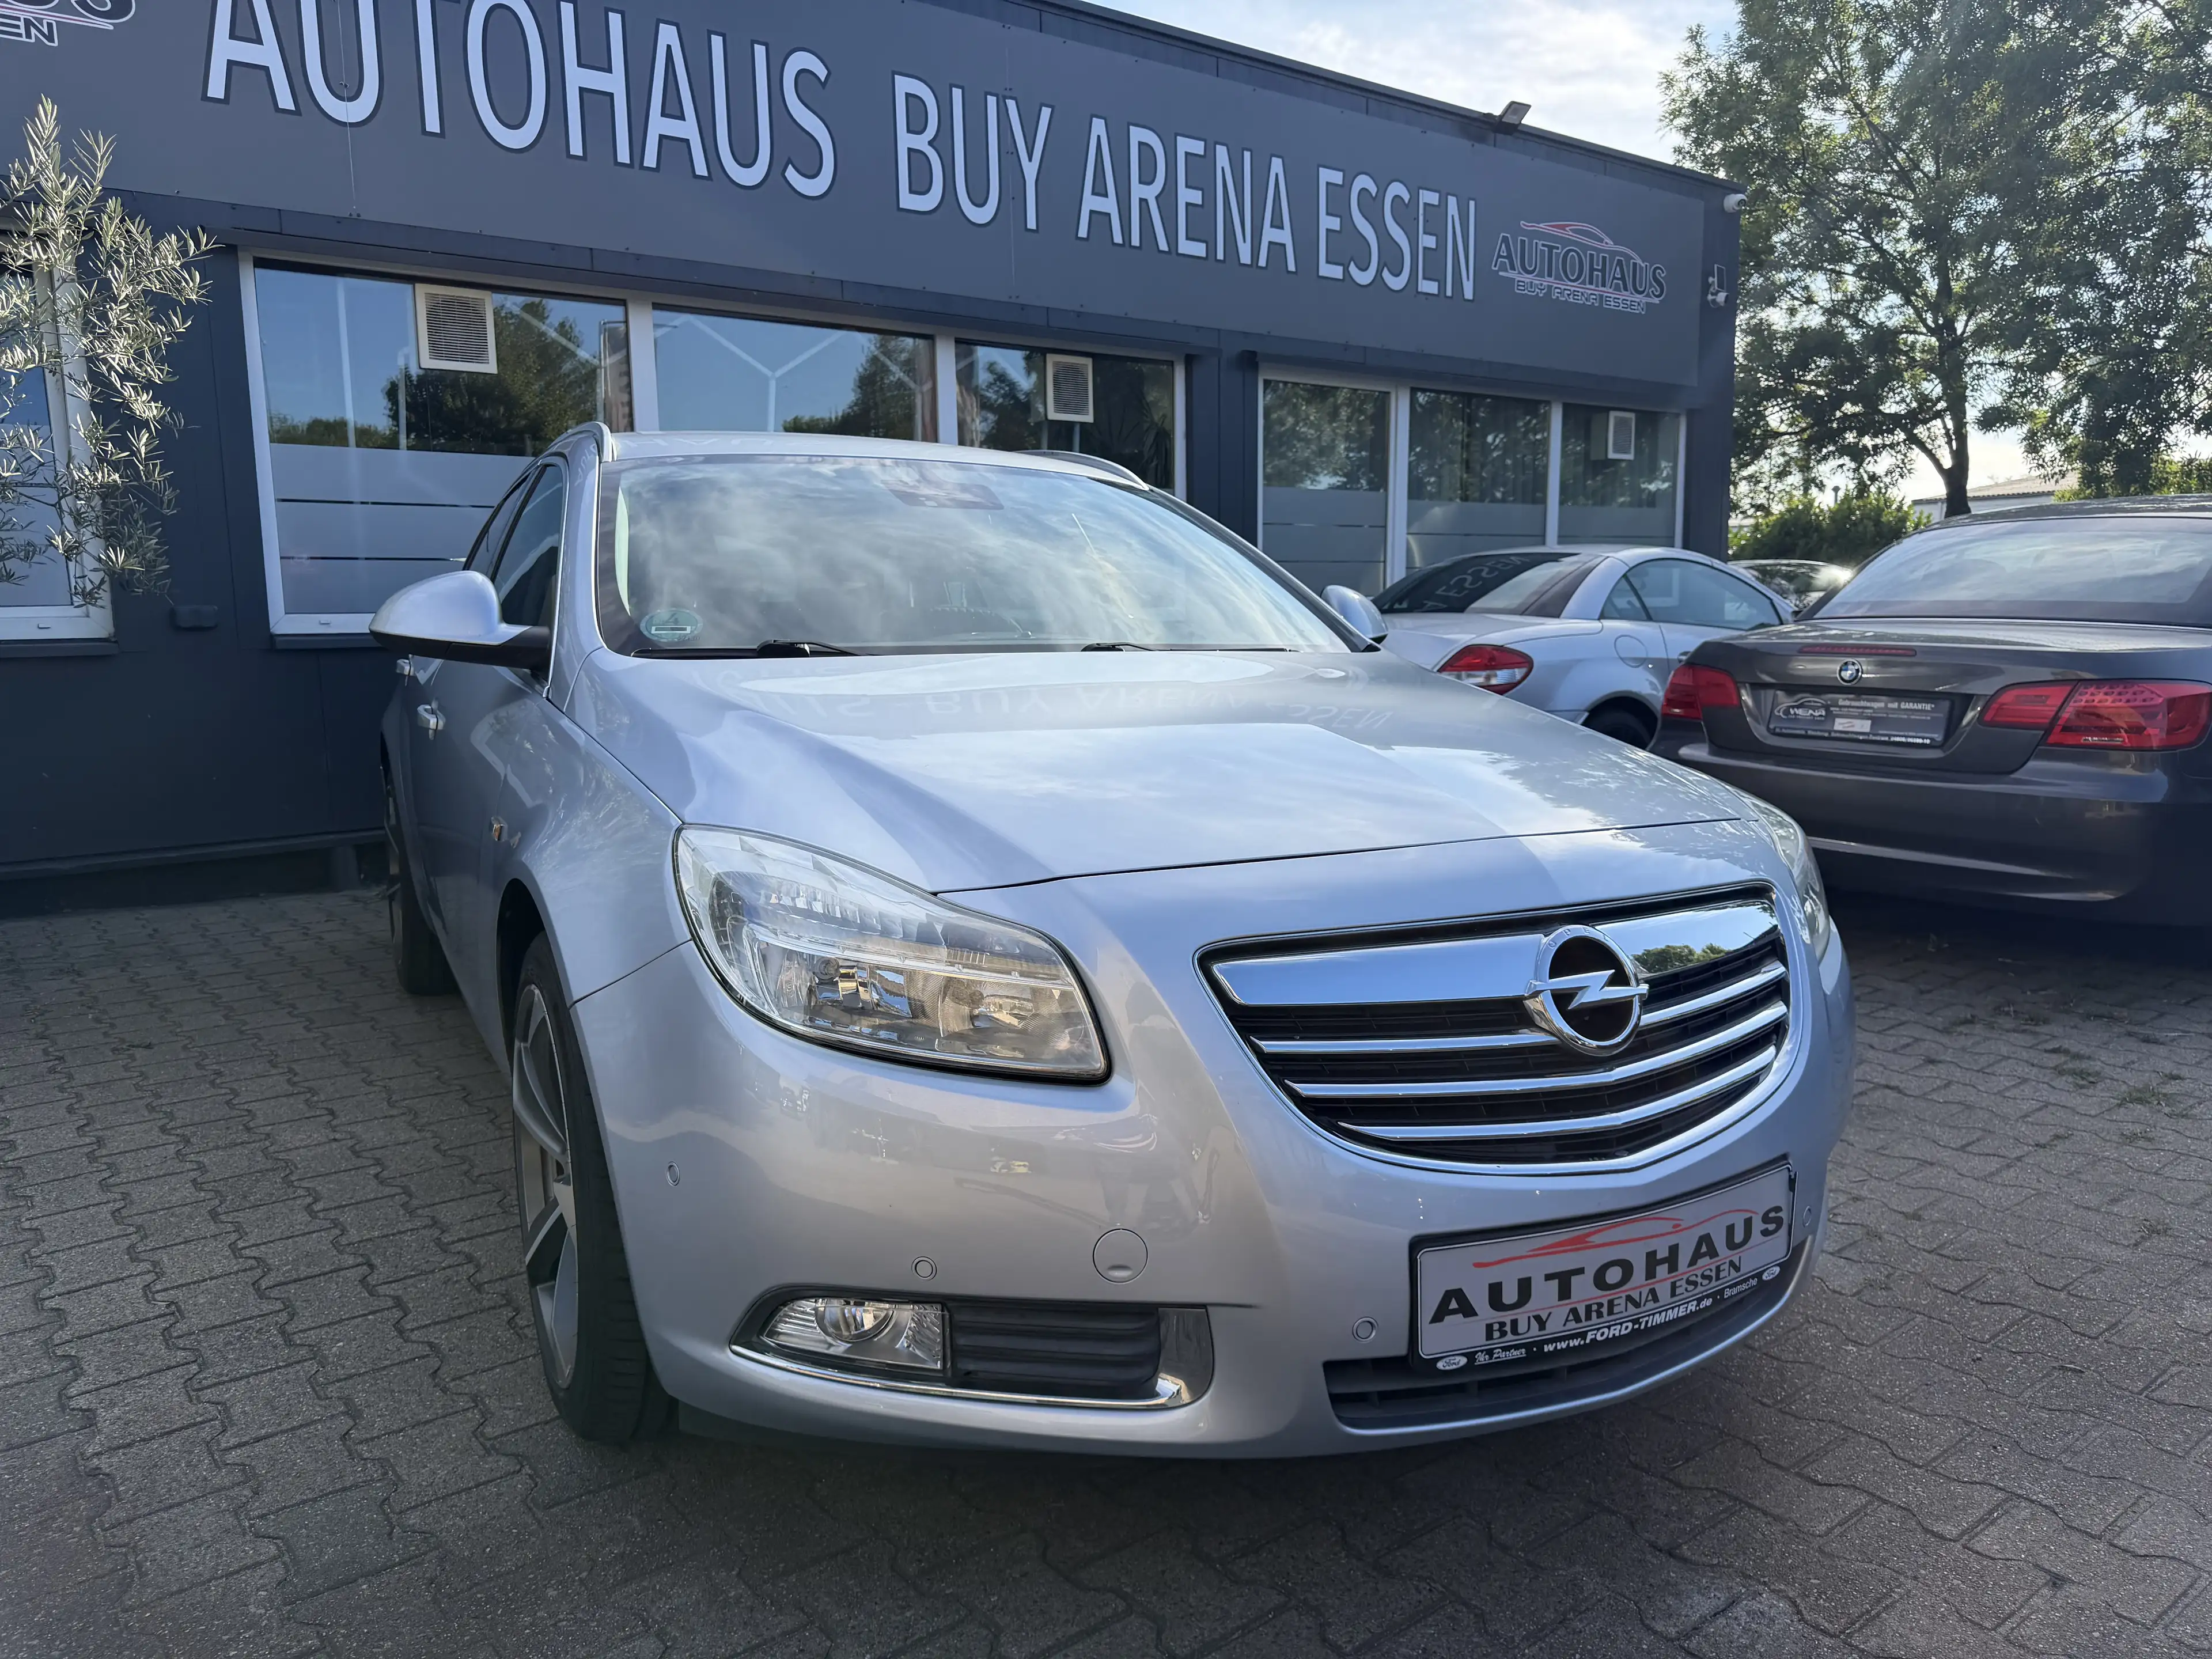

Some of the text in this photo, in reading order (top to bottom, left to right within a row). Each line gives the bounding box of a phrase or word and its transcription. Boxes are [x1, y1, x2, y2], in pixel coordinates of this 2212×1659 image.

[205, 0, 1476, 300] AUTOHAUS BUY ARENA ESSEN
[1491, 233, 1666, 301] AUTOHAUS
[1514, 279, 1647, 314] BUY ARENA ESSEN
[1547, 927, 1609, 948] OPEL
[1429, 1205, 1784, 1325] AUTOHAUS
[1484, 1255, 1741, 1342] BUY ARENA ESSEN
[1492, 1348, 1526, 1360] Partner
[1544, 1296, 1713, 1353] www.FORD-TIMMER.de
[1724, 1278, 1758, 1299] Bramsche
